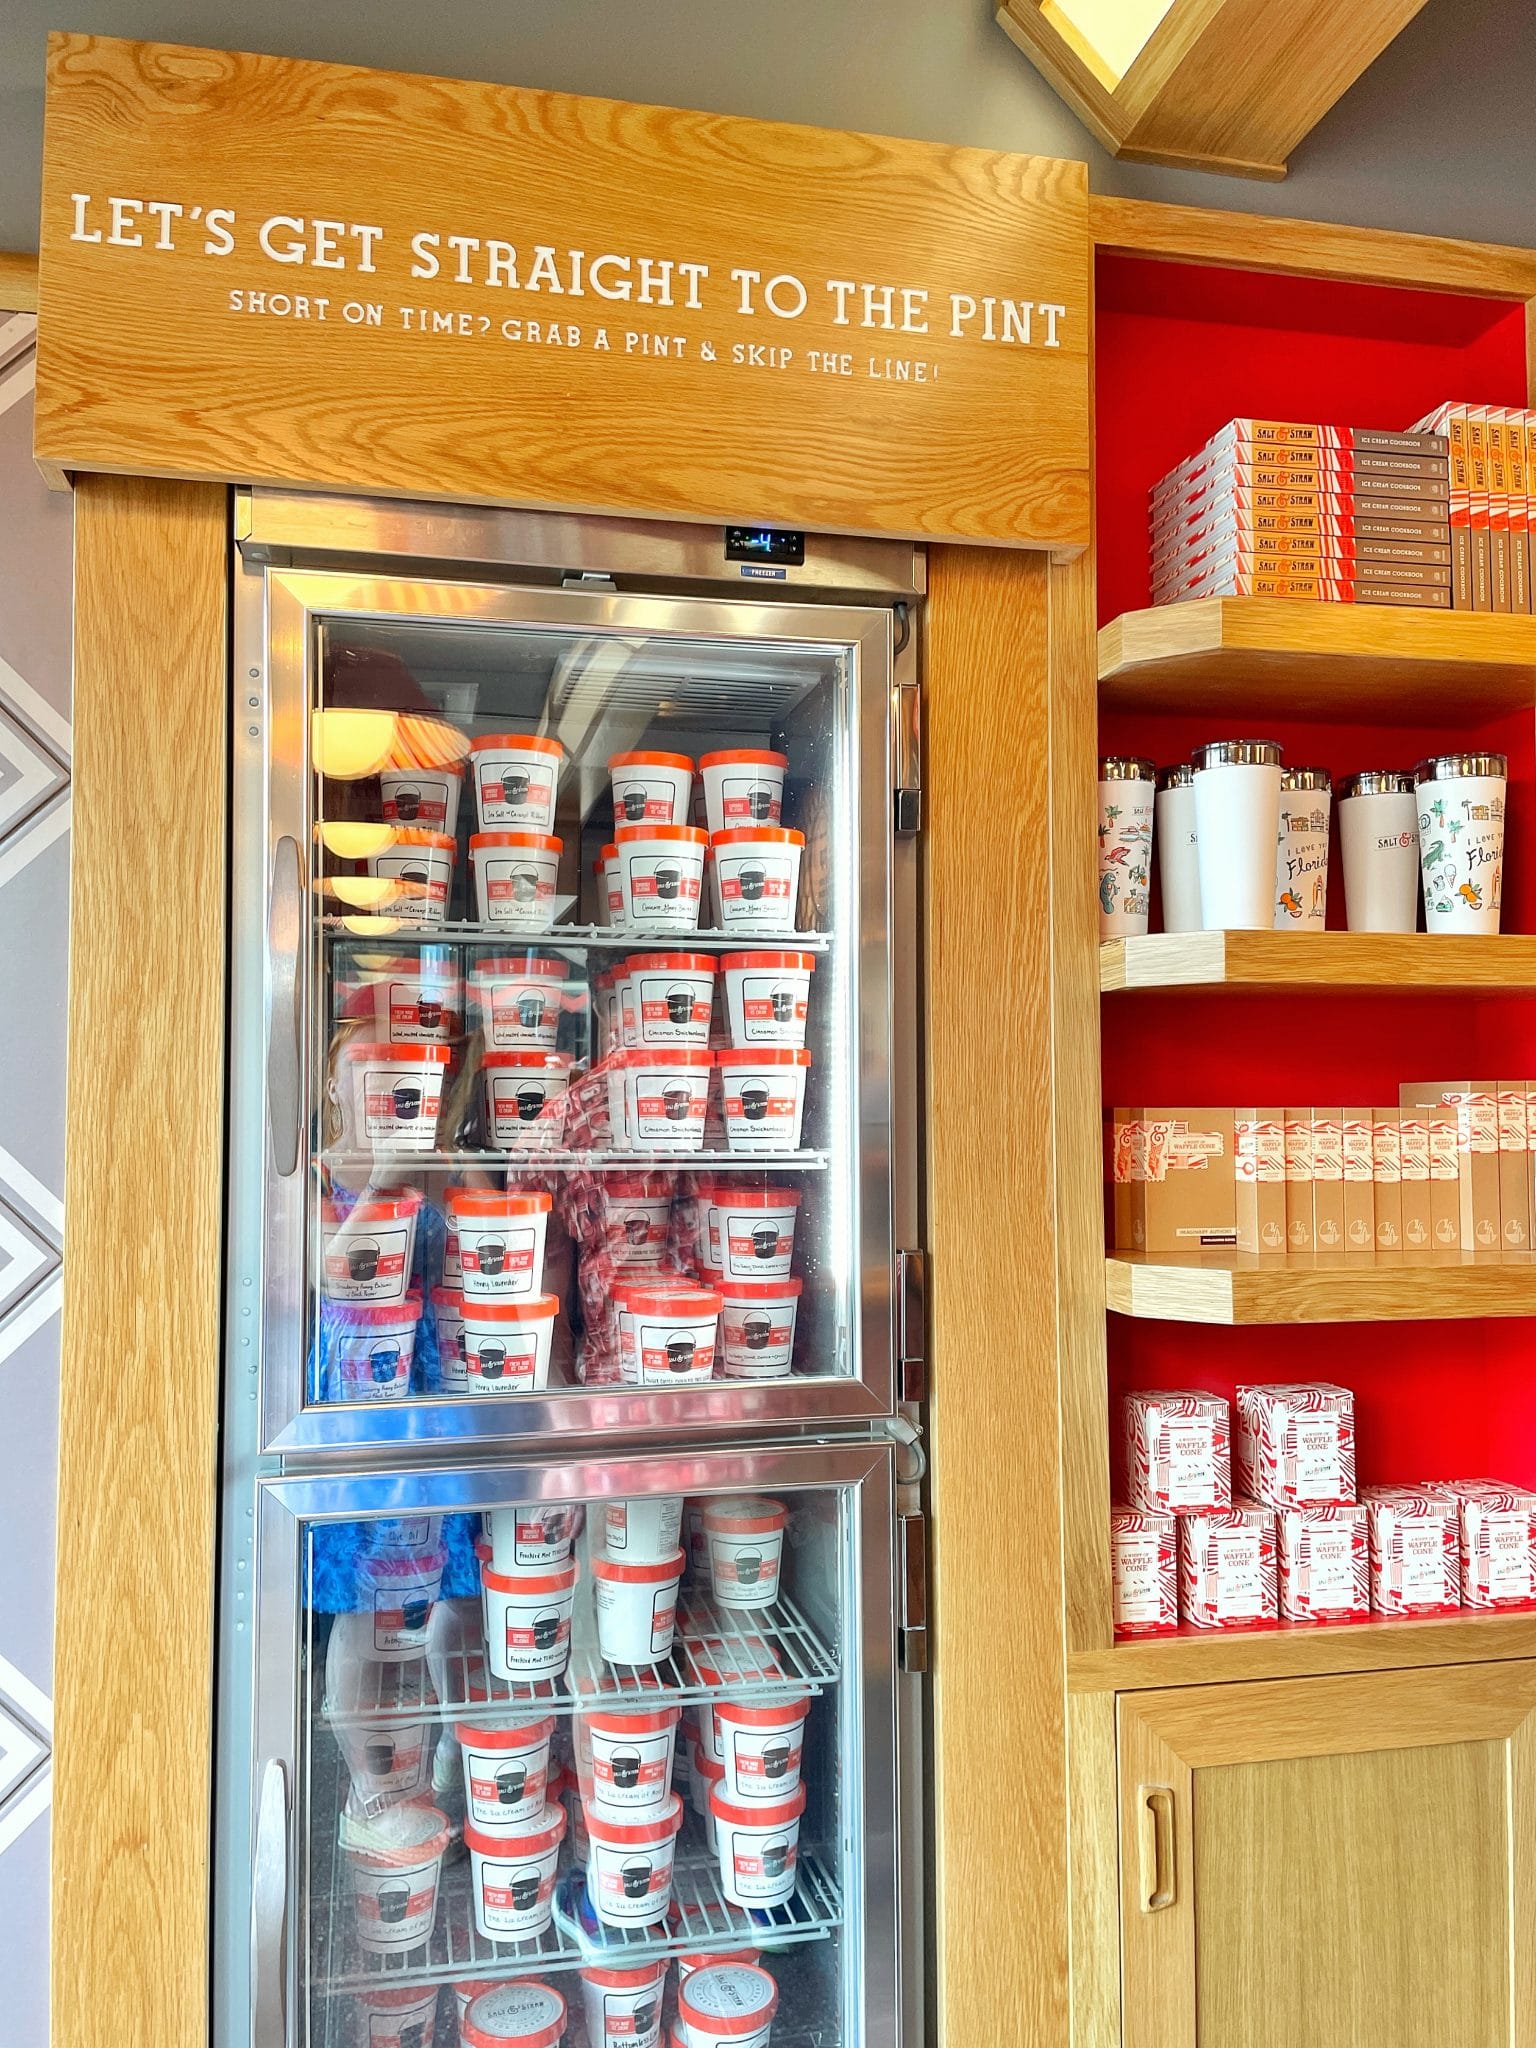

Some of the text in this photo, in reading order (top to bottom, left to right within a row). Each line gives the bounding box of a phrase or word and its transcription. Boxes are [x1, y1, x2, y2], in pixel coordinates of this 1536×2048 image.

[71, 194, 1066, 347] LET'S GET STRAIGHT TO THE PINT
[230, 290, 938, 383] SHORT ON TIME? GRAB A PINT & SKIP THE LINE!
[1257, 429, 1274, 438] SALT
[1290, 430, 1312, 438] STRAW
[1453, 424, 1461, 443] SALT
[1472, 427, 1480, 445] SALT
[1510, 431, 1518, 449] SALT
[1258, 452, 1274, 461] SALT
[1290, 452, 1313, 461] STRAW
[1258, 474, 1274, 483] SALT
[1290, 474, 1313, 483] STRAW
[1258, 496, 1275, 505] SALT
[1290, 496, 1313, 504] STRAW
[1258, 518, 1276, 527] SALT
[1291, 518, 1313, 527] STRAW
[1259, 539, 1277, 549] SALT
[1292, 539, 1314, 548] STRAW
[1259, 561, 1277, 570] SALT
[1292, 561, 1314, 570] STRAW
[1257, 582, 1275, 592] SALT
[1290, 582, 1313, 591] STRAW
[1378, 838, 1397, 848] SALT
[1400, 832, 1411, 847] &
[1476, 834, 1494, 844] LOVE
[1296, 844, 1314, 854] LOVE
[488, 2010, 506, 2018] SALT
[518, 2001, 544, 2010] STRAW
